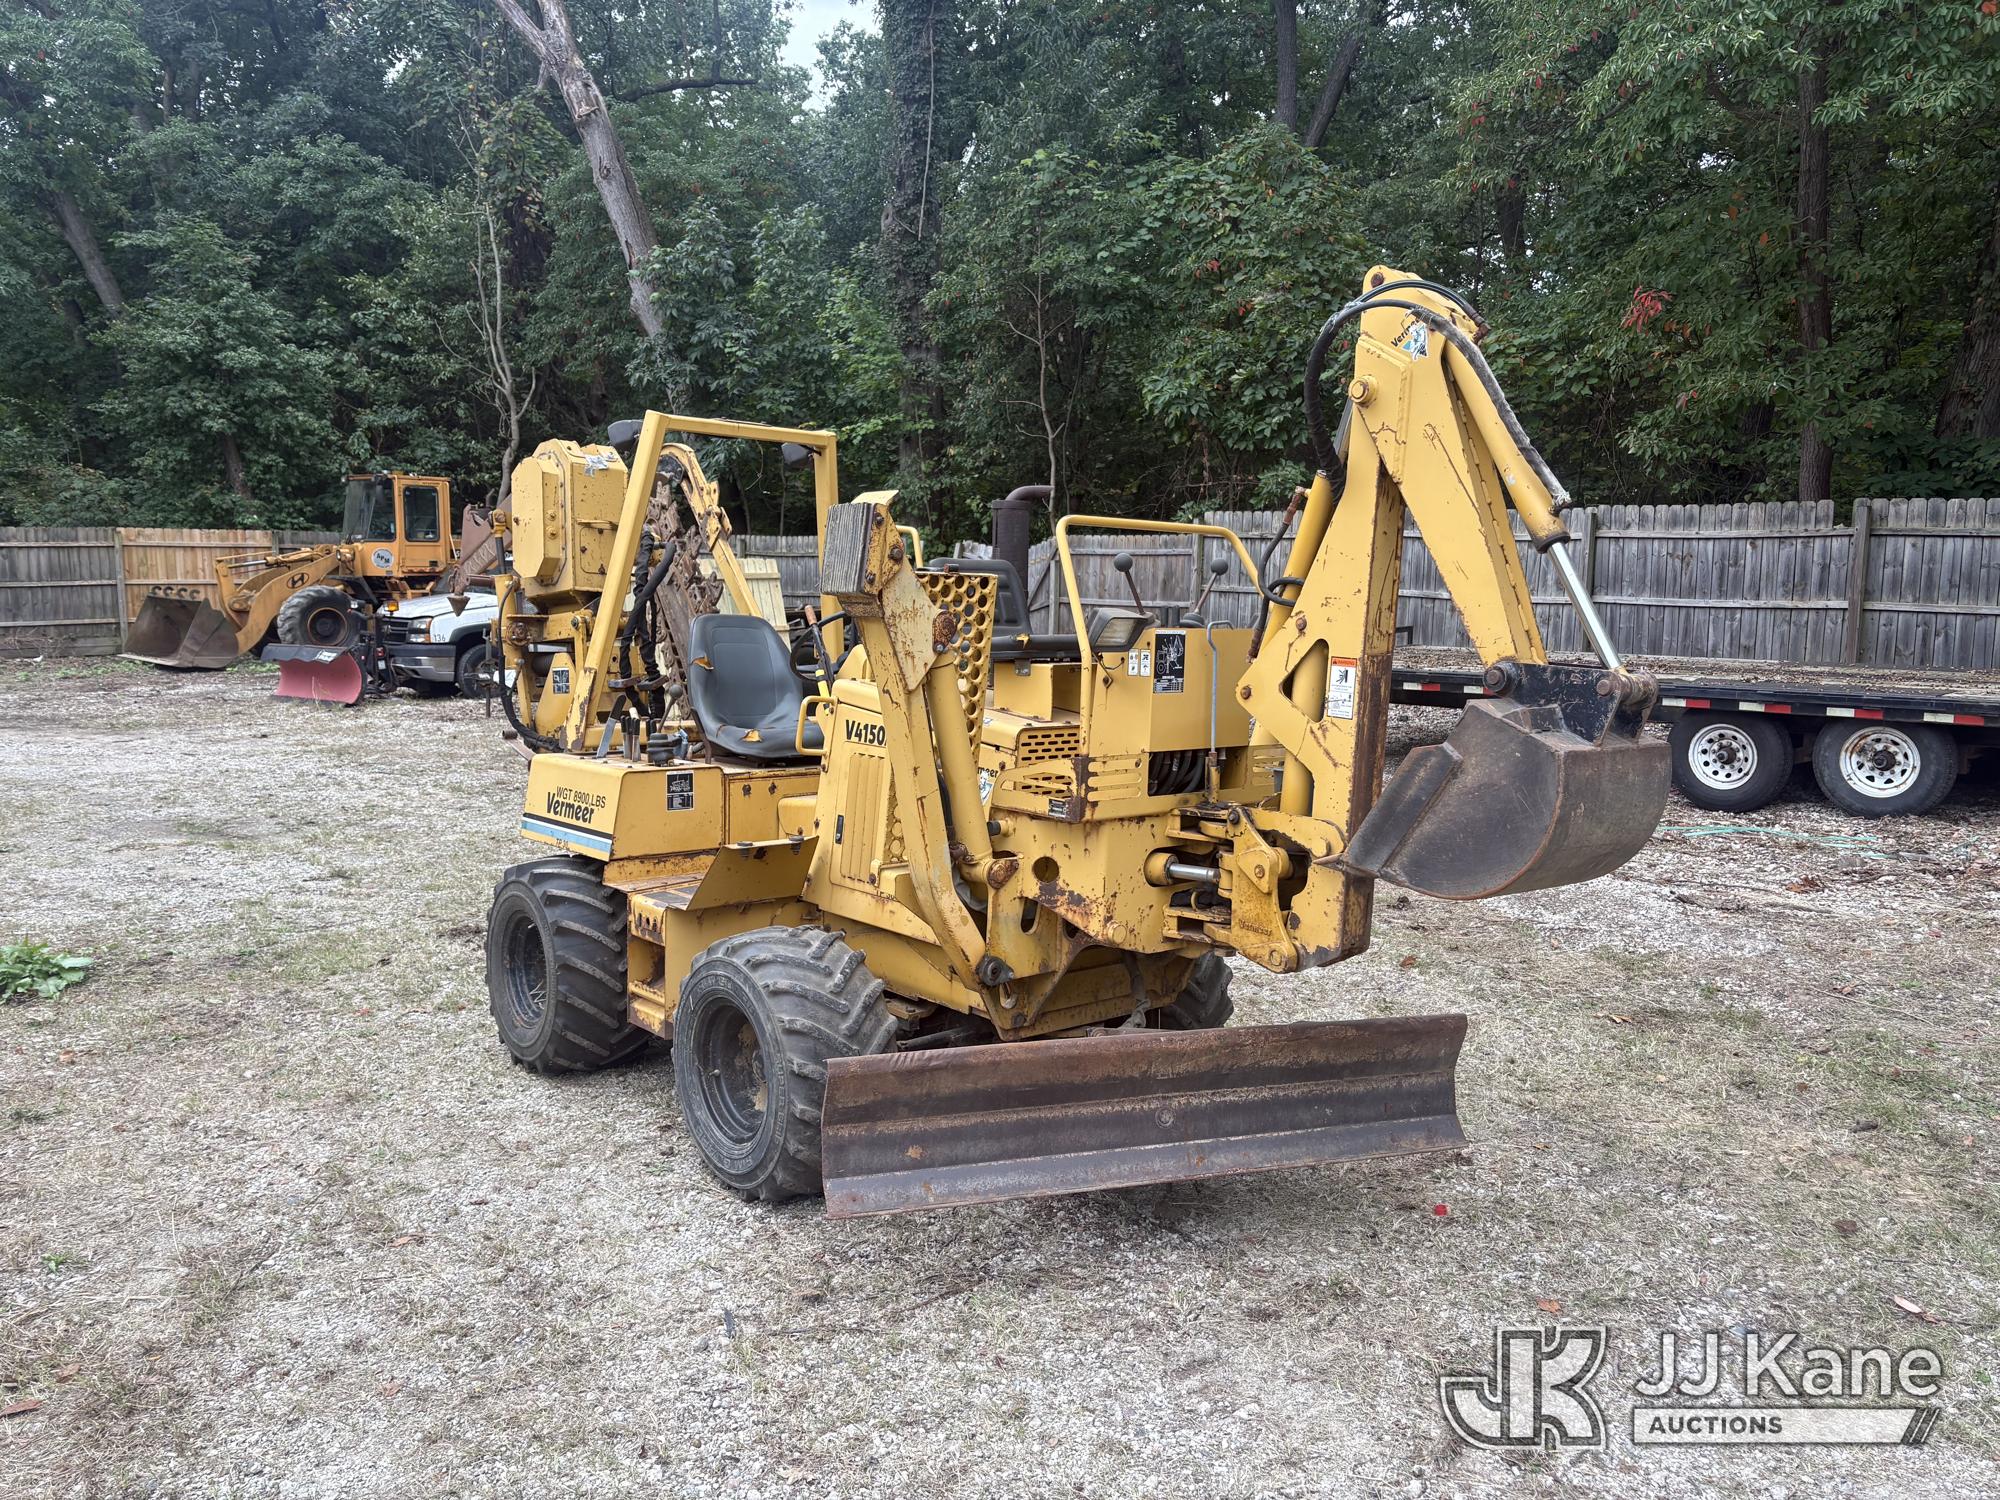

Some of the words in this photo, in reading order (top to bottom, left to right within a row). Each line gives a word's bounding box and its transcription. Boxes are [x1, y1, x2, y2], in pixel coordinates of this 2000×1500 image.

[433, 634, 446, 642] 136
[845, 719, 887, 747] V4150
[556, 786, 573, 800] WGT
[547, 792, 594, 824] Vermeer
